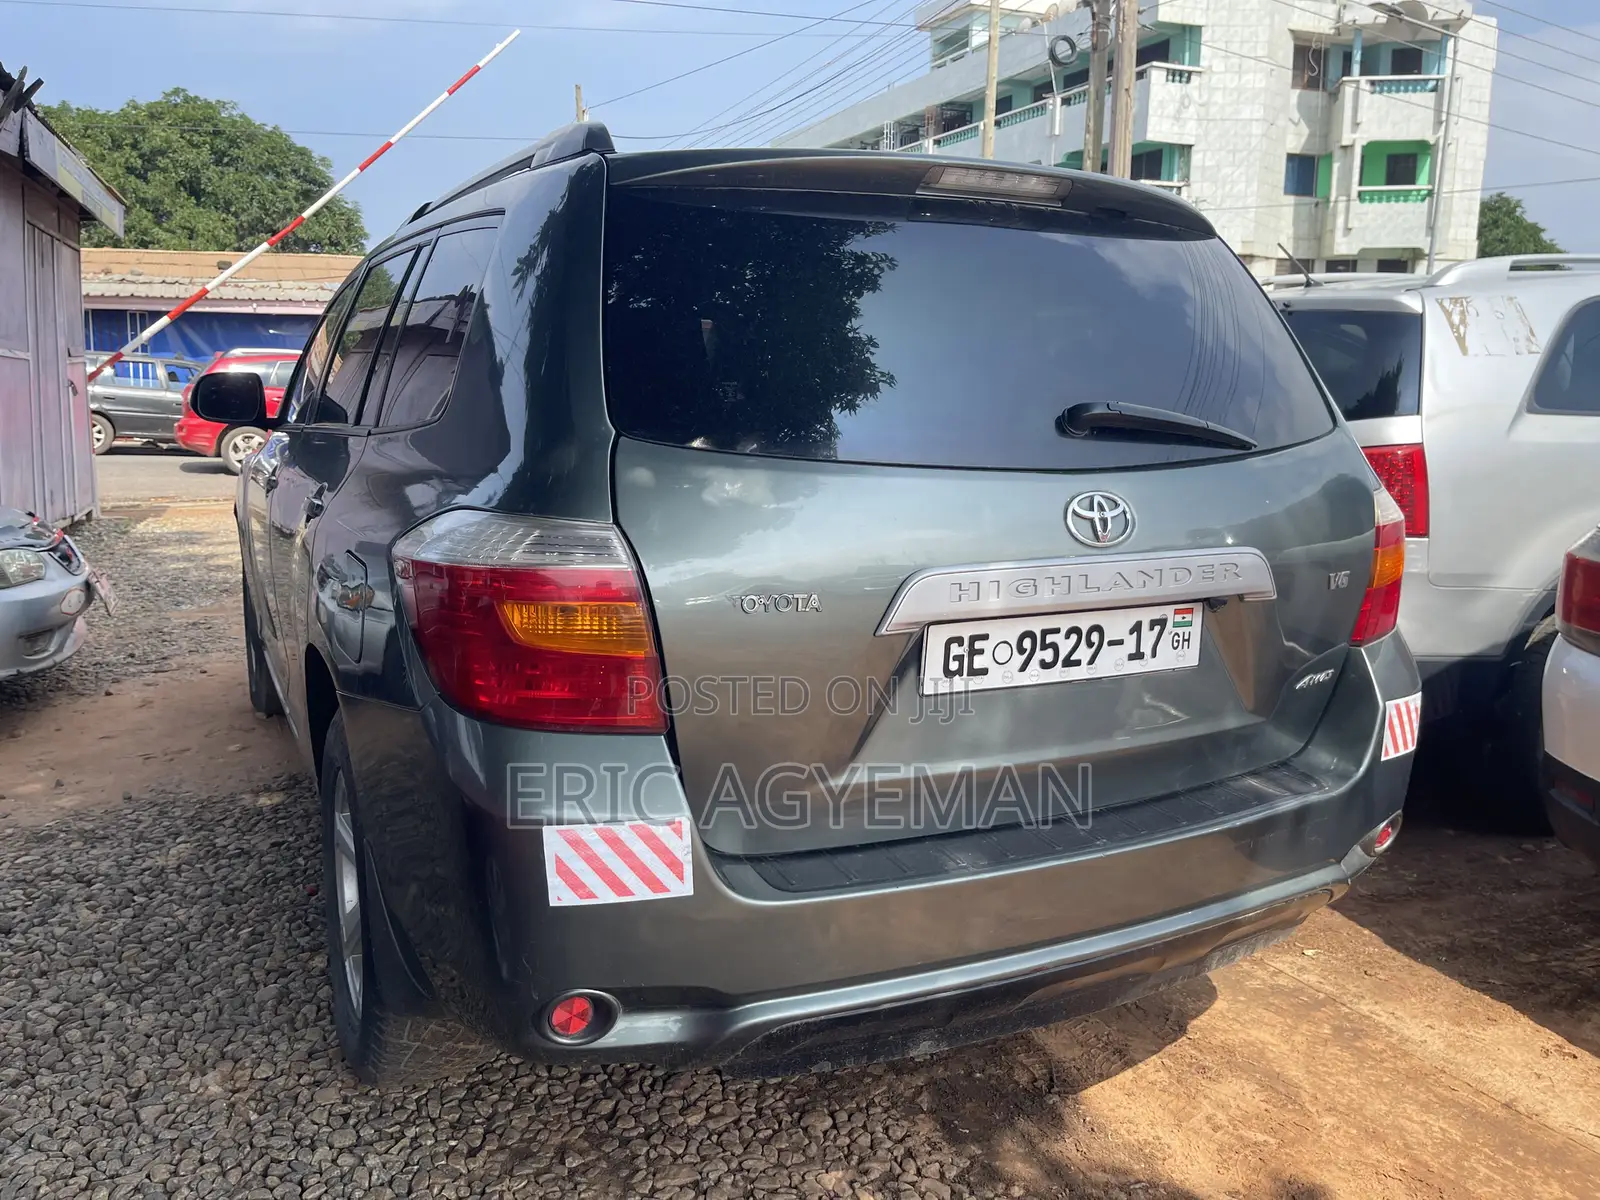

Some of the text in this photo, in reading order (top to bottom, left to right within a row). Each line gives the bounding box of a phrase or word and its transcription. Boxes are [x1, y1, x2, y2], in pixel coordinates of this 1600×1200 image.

[949, 562, 1243, 602] HIGHLANDER
[1328, 570, 1351, 590] V6
[942, 617, 1169, 679] GE 9529-17
[1171, 631, 1191, 650] GH
